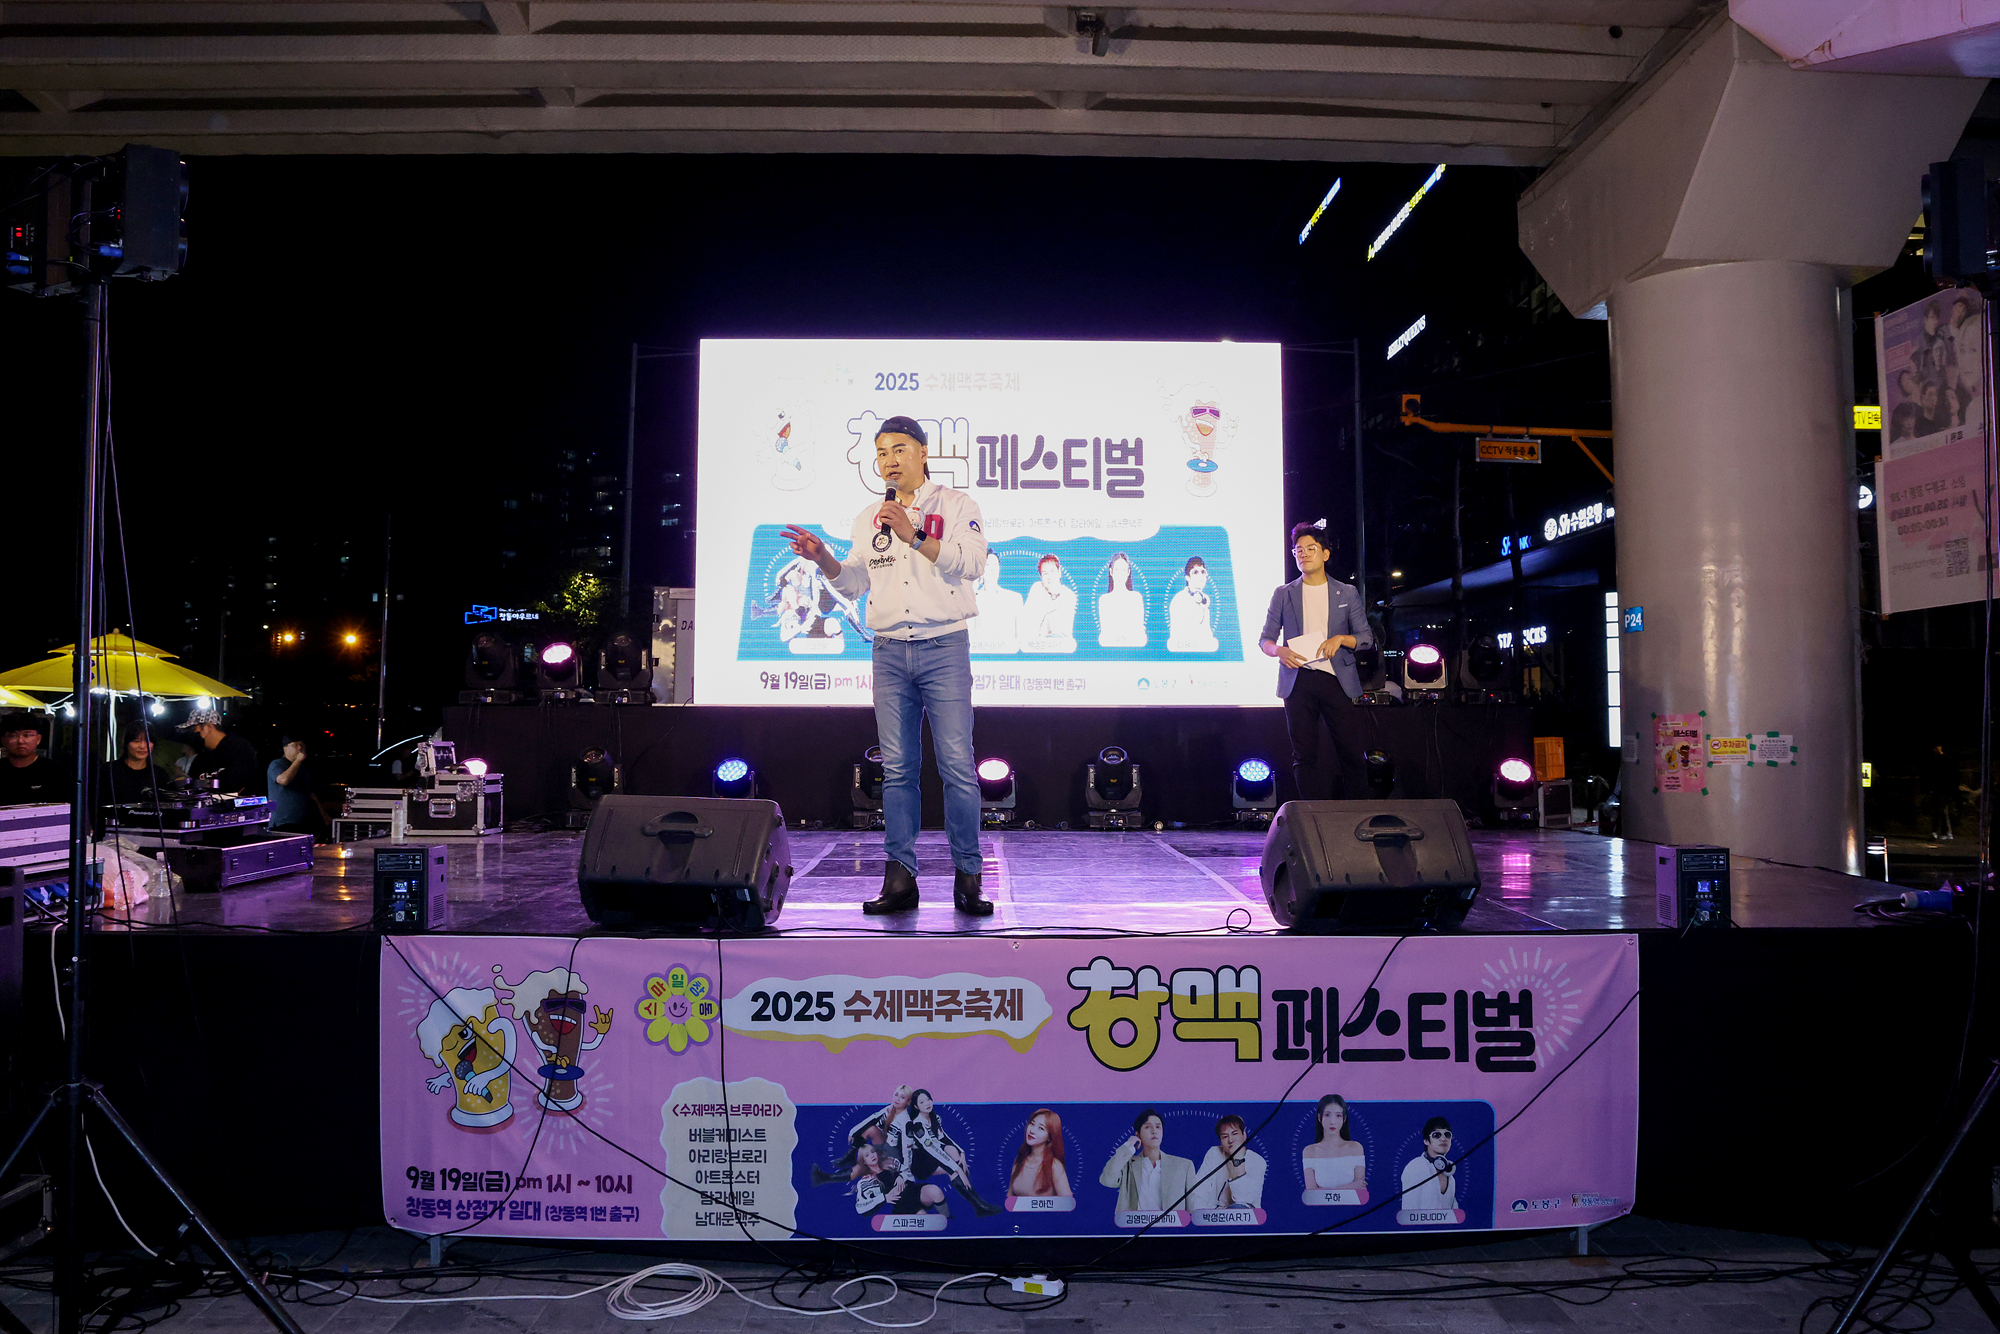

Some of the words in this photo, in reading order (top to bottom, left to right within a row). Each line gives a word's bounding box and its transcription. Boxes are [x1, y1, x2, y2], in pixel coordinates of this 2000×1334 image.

[874, 371, 920, 391] 2025
[924, 371, 1021, 392] 수제맥주축제
[1480, 445, 1503, 455] CCTV
[975, 433, 1145, 499] 페스티벌
[1624, 612, 1643, 628] P24
[760, 671, 780, 689] 9월
[784, 671, 831, 690] 19일(금)
[835, 677, 853, 688] pm
[855, 674, 872, 690] 1시
[971, 674, 996, 691] 점가
[999, 674, 1021, 691] 일대
[1023, 678, 1052, 691] (창동역
[1053, 678, 1064, 691] 1번
[1066, 678, 1086, 691] 출구)
[1722, 740, 1748, 749] 주차금지
[750, 990, 836, 1022] 2025
[843, 987, 1024, 1022] 수제맥주축제
[1067, 955, 1262, 1072] 창맥
[1271, 986, 1538, 1073] 페스티벌
[672, 1103, 728, 1117] <수제맥주
[730, 1103, 784, 1117] 브루어리>
[688, 1127, 767, 1143] 버블케미스트
[688, 1149, 767, 1164] 아리랑브로리
[406, 1166, 435, 1190] 9월
[439, 1168, 511, 1193] 19일(금)
[515, 1174, 542, 1189] pm
[546, 1173, 571, 1193] 1시
[595, 1174, 633, 1194] 10시
[695, 1170, 760, 1184] 아트몬스터
[1030, 1199, 1054, 1209] 은하진
[1324, 1193, 1341, 1202] 주하
[1531, 1198, 1561, 1210] 도봉구
[406, 1196, 451, 1219] 창동역
[455, 1199, 506, 1221] 상점가
[508, 1200, 541, 1221] 일대
[545, 1205, 588, 1222] (창동역
[590, 1206, 607, 1222] 1번
[609, 1206, 640, 1222] 출구)
[892, 1218, 925, 1229] 스파크밤
[1409, 1213, 1419, 1222] DJ
[1420, 1212, 1448, 1221] BUDDY
